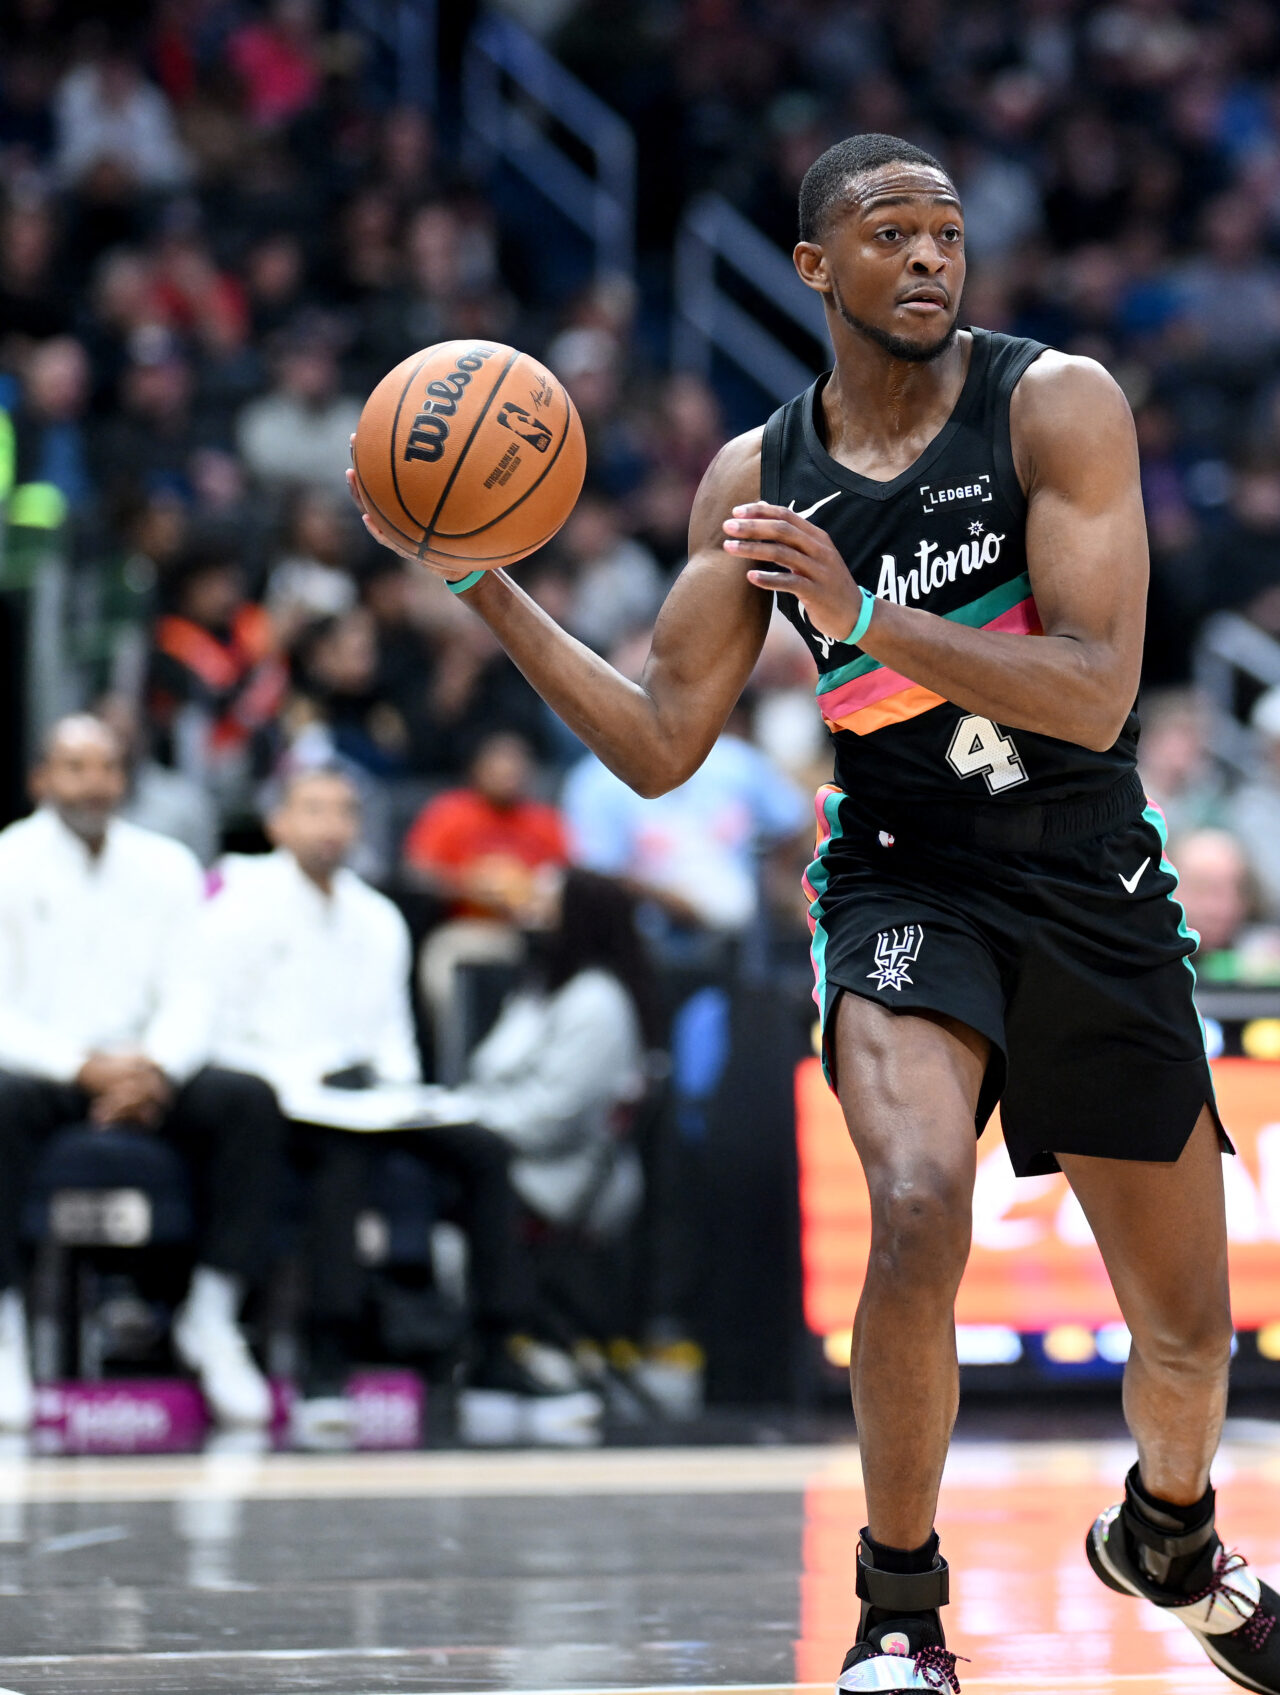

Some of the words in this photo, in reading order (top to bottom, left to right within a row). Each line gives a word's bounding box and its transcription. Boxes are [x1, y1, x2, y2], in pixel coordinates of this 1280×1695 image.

[404, 345, 498, 463] Wilson
[930, 484, 982, 504] LEDGER
[876, 521, 1005, 606] Antonio
[945, 713, 1029, 796] 4
